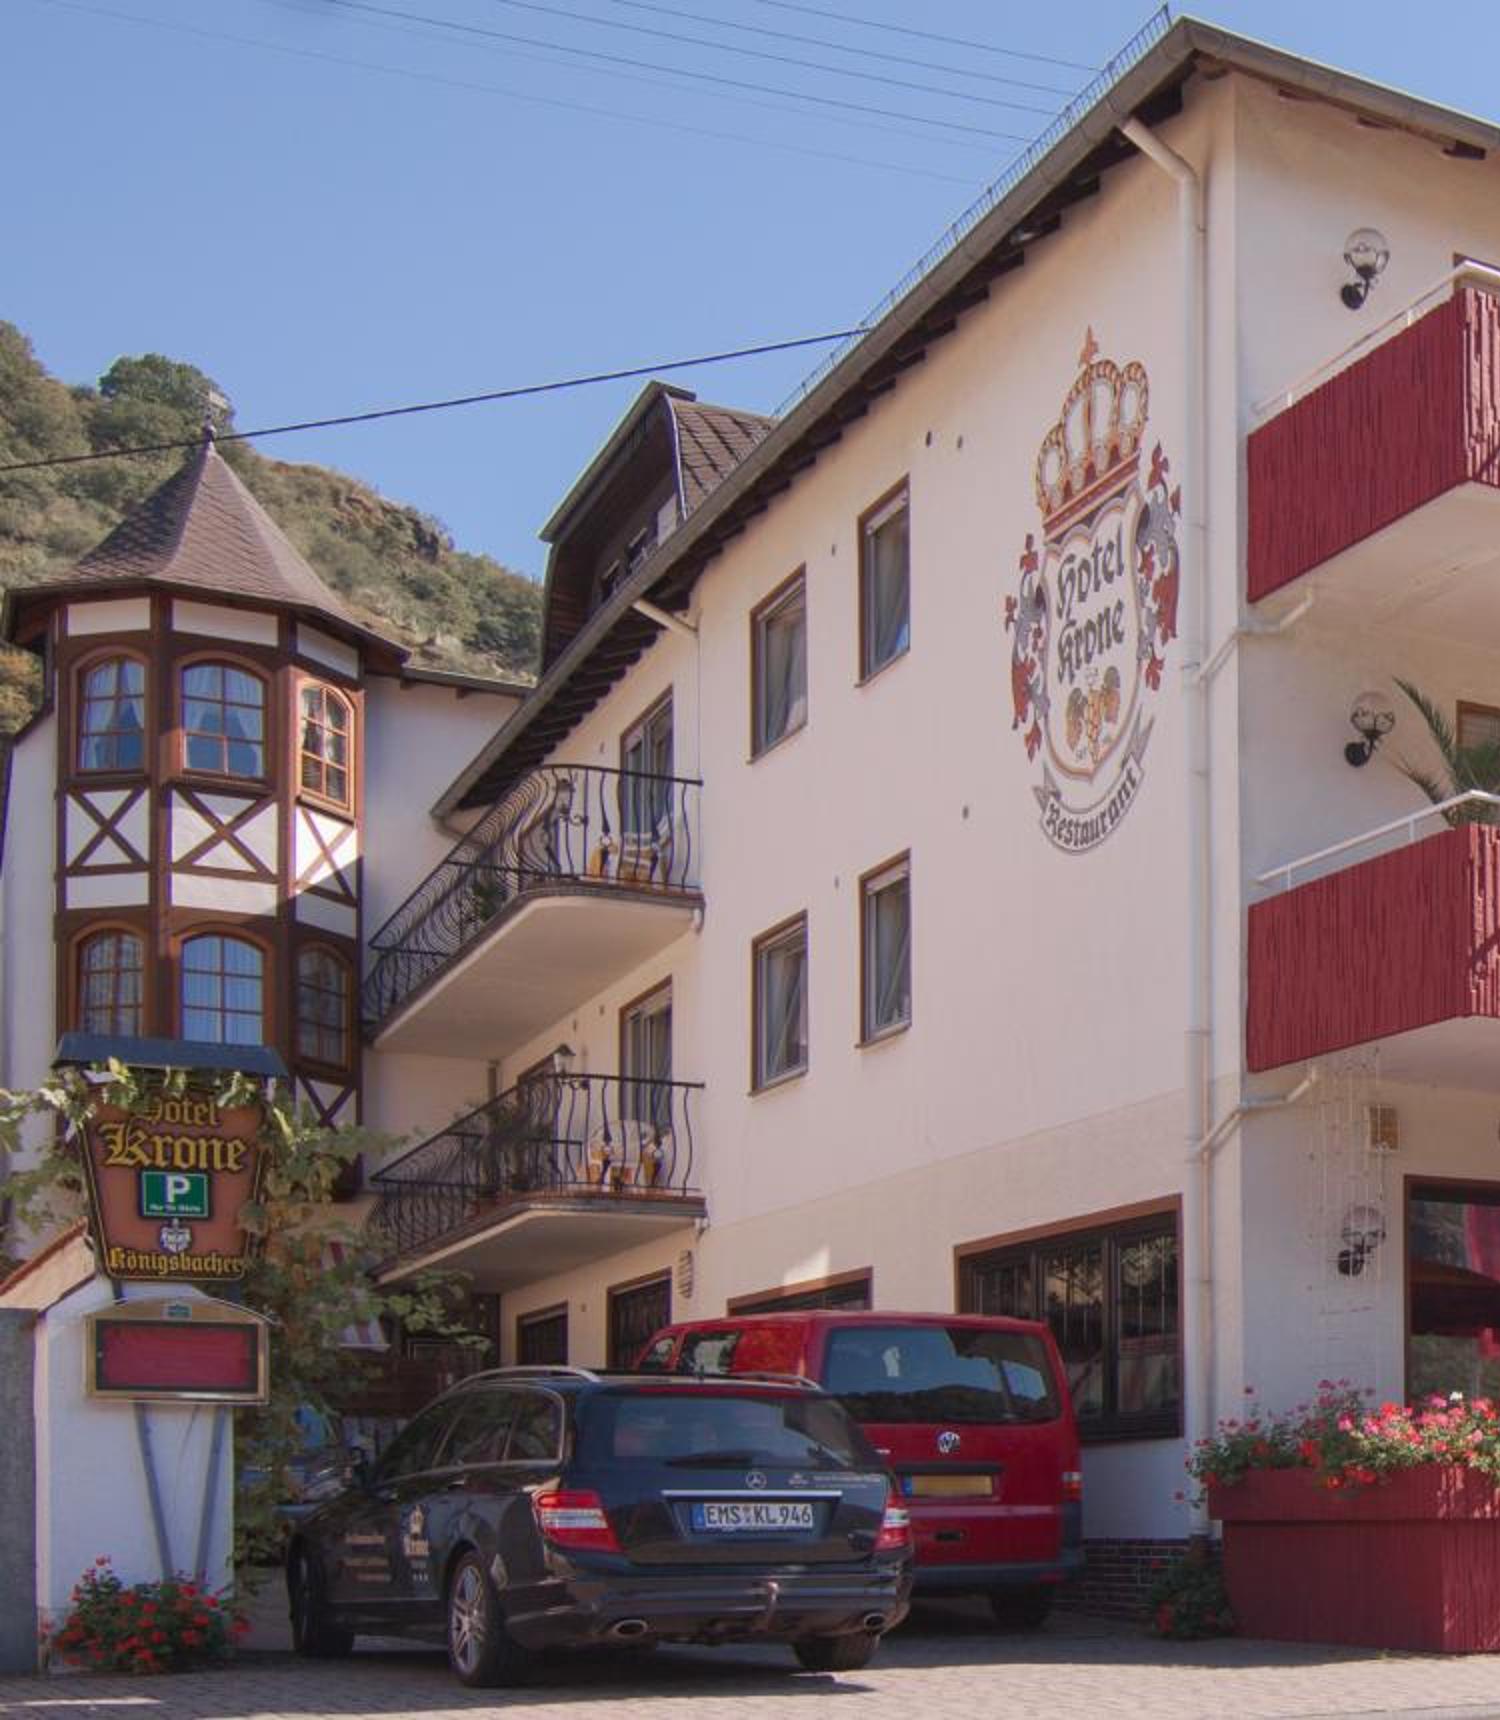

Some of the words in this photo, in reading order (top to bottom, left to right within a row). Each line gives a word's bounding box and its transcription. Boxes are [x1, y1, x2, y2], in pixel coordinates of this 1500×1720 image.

[1057, 521, 1124, 621] Hotel
[1058, 598, 1125, 685] Krone
[1046, 768, 1137, 847] Restaurant
[98, 1120, 247, 1171] Krone
[167, 1174, 191, 1203] P
[110, 1247, 243, 1275] Königsbacher
[706, 1505, 740, 1524] EMS
[780, 1506, 812, 1525] 946
